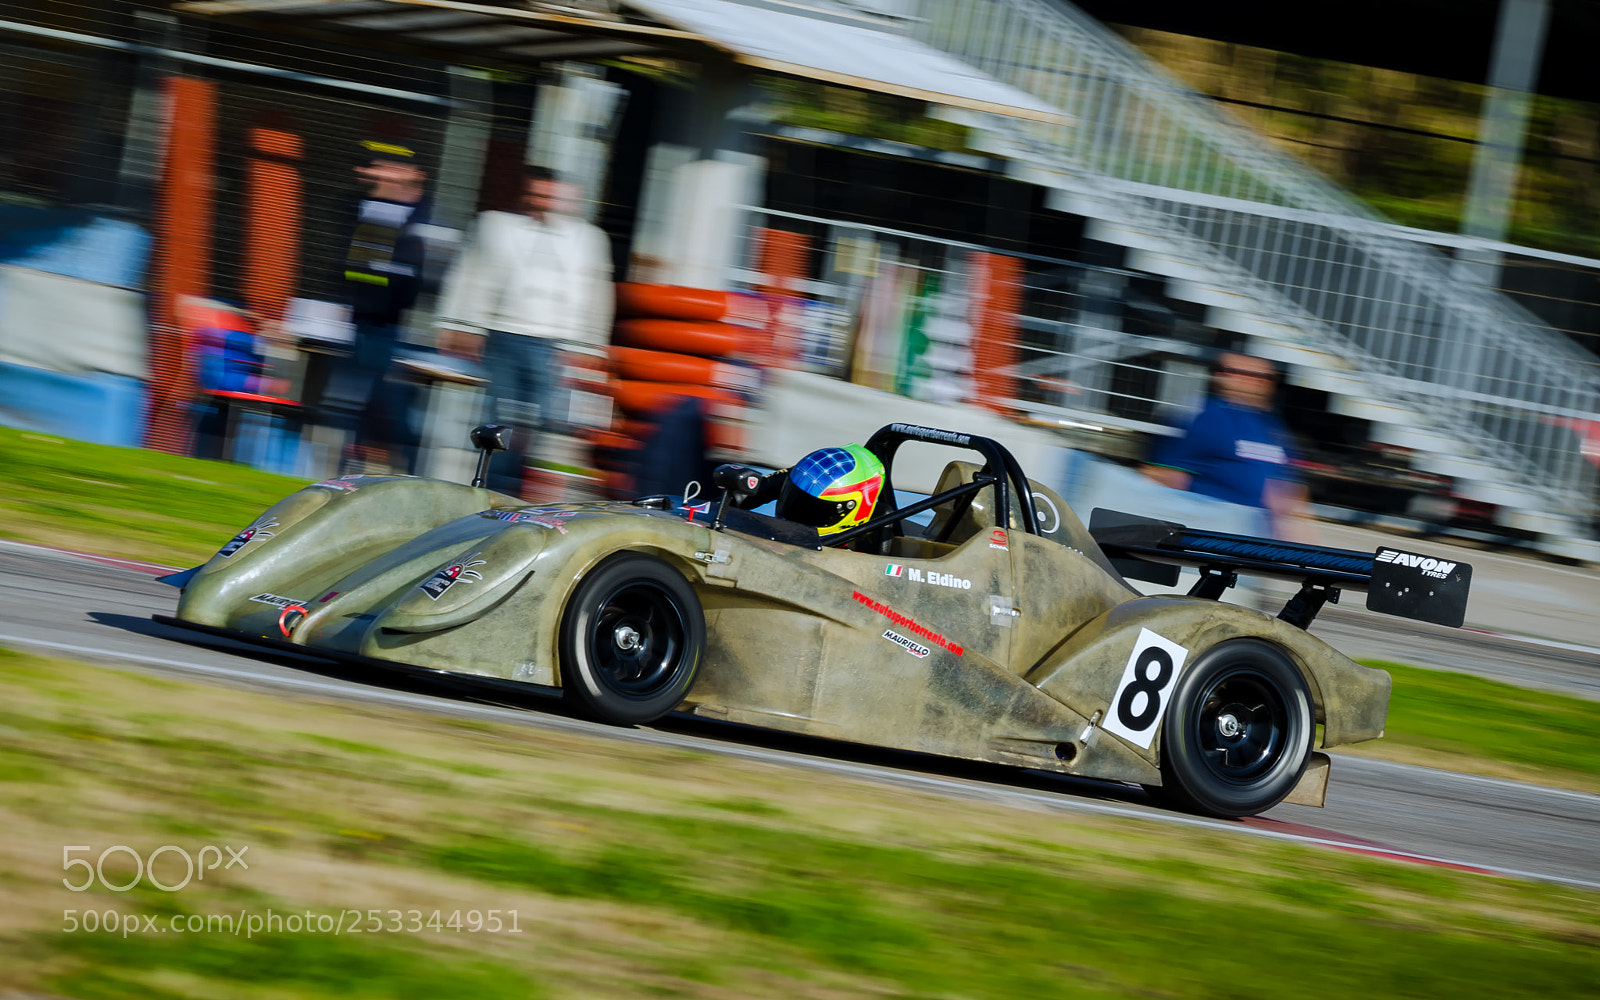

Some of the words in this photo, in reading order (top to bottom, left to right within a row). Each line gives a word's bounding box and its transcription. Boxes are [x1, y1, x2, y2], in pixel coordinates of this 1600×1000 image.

[908, 568, 926, 583] M.
[927, 572, 972, 590] Eldino
[1421, 569, 1448, 580] TYRES
[852, 590, 964, 657] www.autosportsorrento.com
[884, 631, 929, 656] MAURIELLO
[1117, 646, 1174, 731] 8
